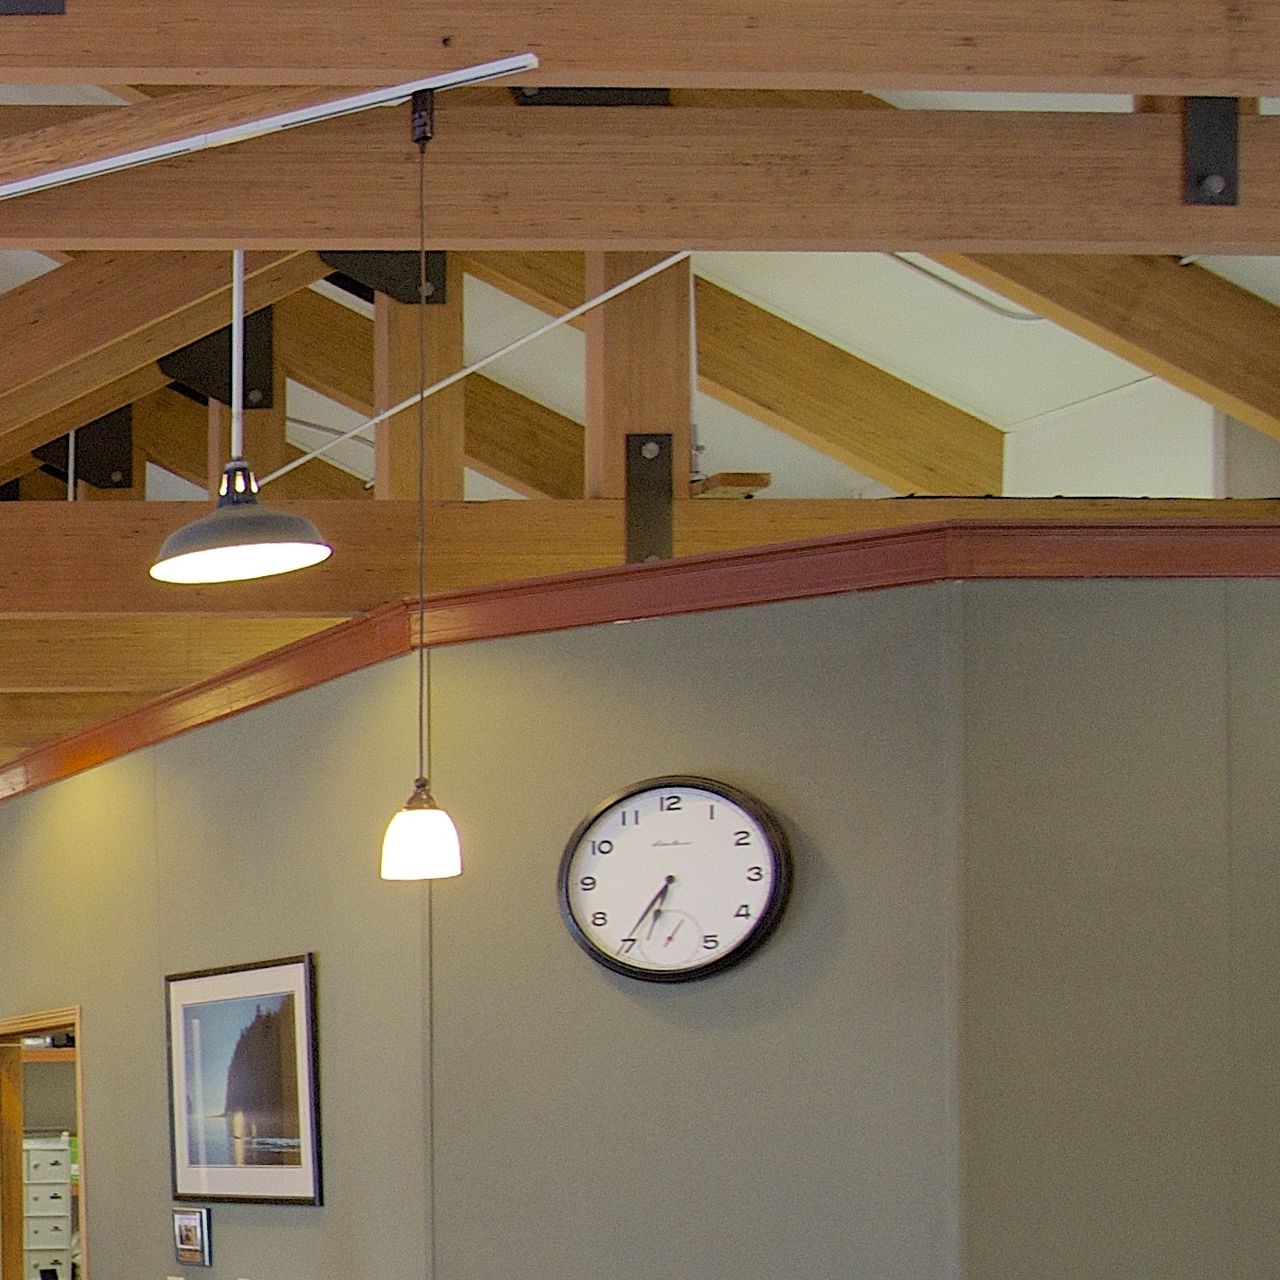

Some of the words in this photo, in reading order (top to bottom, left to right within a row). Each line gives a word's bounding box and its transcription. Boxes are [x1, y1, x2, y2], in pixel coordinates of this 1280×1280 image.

[659, 795, 682, 811] 12
[621, 810, 640, 826] 11
[709, 805, 715, 820] 1
[734, 831, 751, 846] 2
[591, 840, 613, 855] 10
[746, 866, 763, 882] 3
[580, 876, 597, 891] 9
[591, 911, 608, 927] 8
[734, 904, 751, 920] 4
[621, 938, 637, 954] 7
[703, 934, 719, 950] 5
